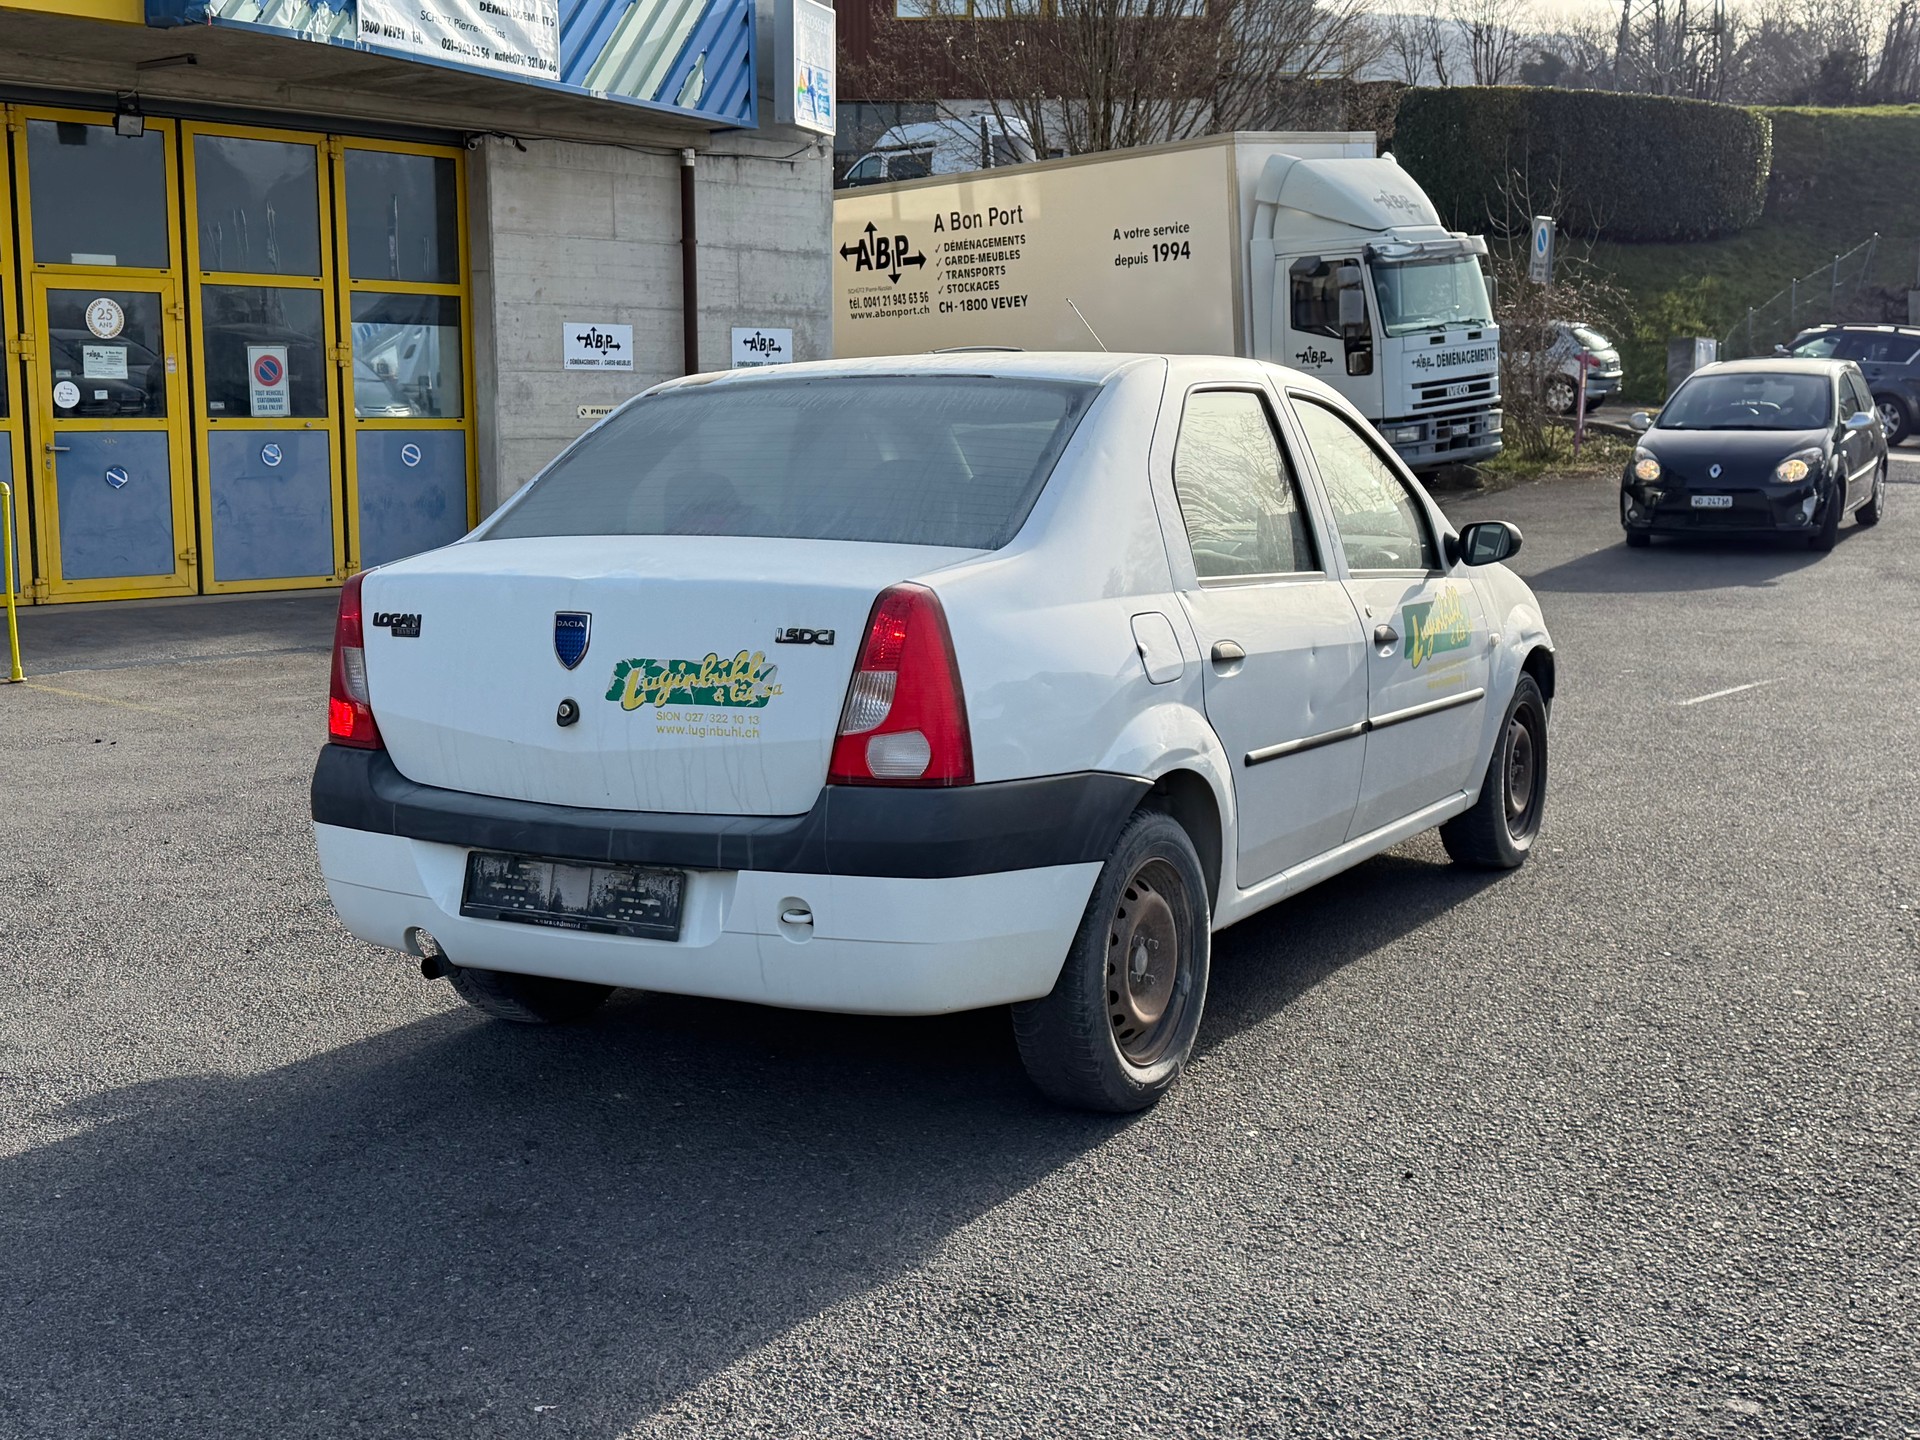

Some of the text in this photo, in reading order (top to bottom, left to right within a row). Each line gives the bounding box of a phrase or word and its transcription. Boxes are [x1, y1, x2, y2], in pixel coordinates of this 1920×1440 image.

[361, 19, 380, 34] 1800
[383, 23, 406, 40] VEVEY
[933, 205, 1024, 233] A Bon Port
[1113, 221, 1190, 240] A votre service
[943, 234, 1026, 252] DÉMÉNAGEMENTS
[843, 234, 924, 273] ABP
[944, 249, 1021, 267] GARDE-MEUBLES
[1114, 240, 1191, 268] depuis 1994
[945, 265, 1006, 281] TRANSPORTS
[946, 280, 1000, 295] STOCKAGES
[849, 290, 929, 309] tél. 0041 21 943 63 56
[991, 294, 1028, 310] VEVEY
[97, 307, 113, 321] 25
[850, 304, 931, 320] www.abonport.ch
[1436, 347, 1496, 368] DÉMÉNAGEMENTS
[1446, 384, 1469, 397] IVECO
[372, 612, 422, 628] LOGAN
[556, 620, 585, 628] DACIA
[656, 712, 680, 720] SION
[733, 715, 744, 724] 10
[749, 716, 760, 725] 13
[656, 725, 760, 738] www.luginbuhl.ch
